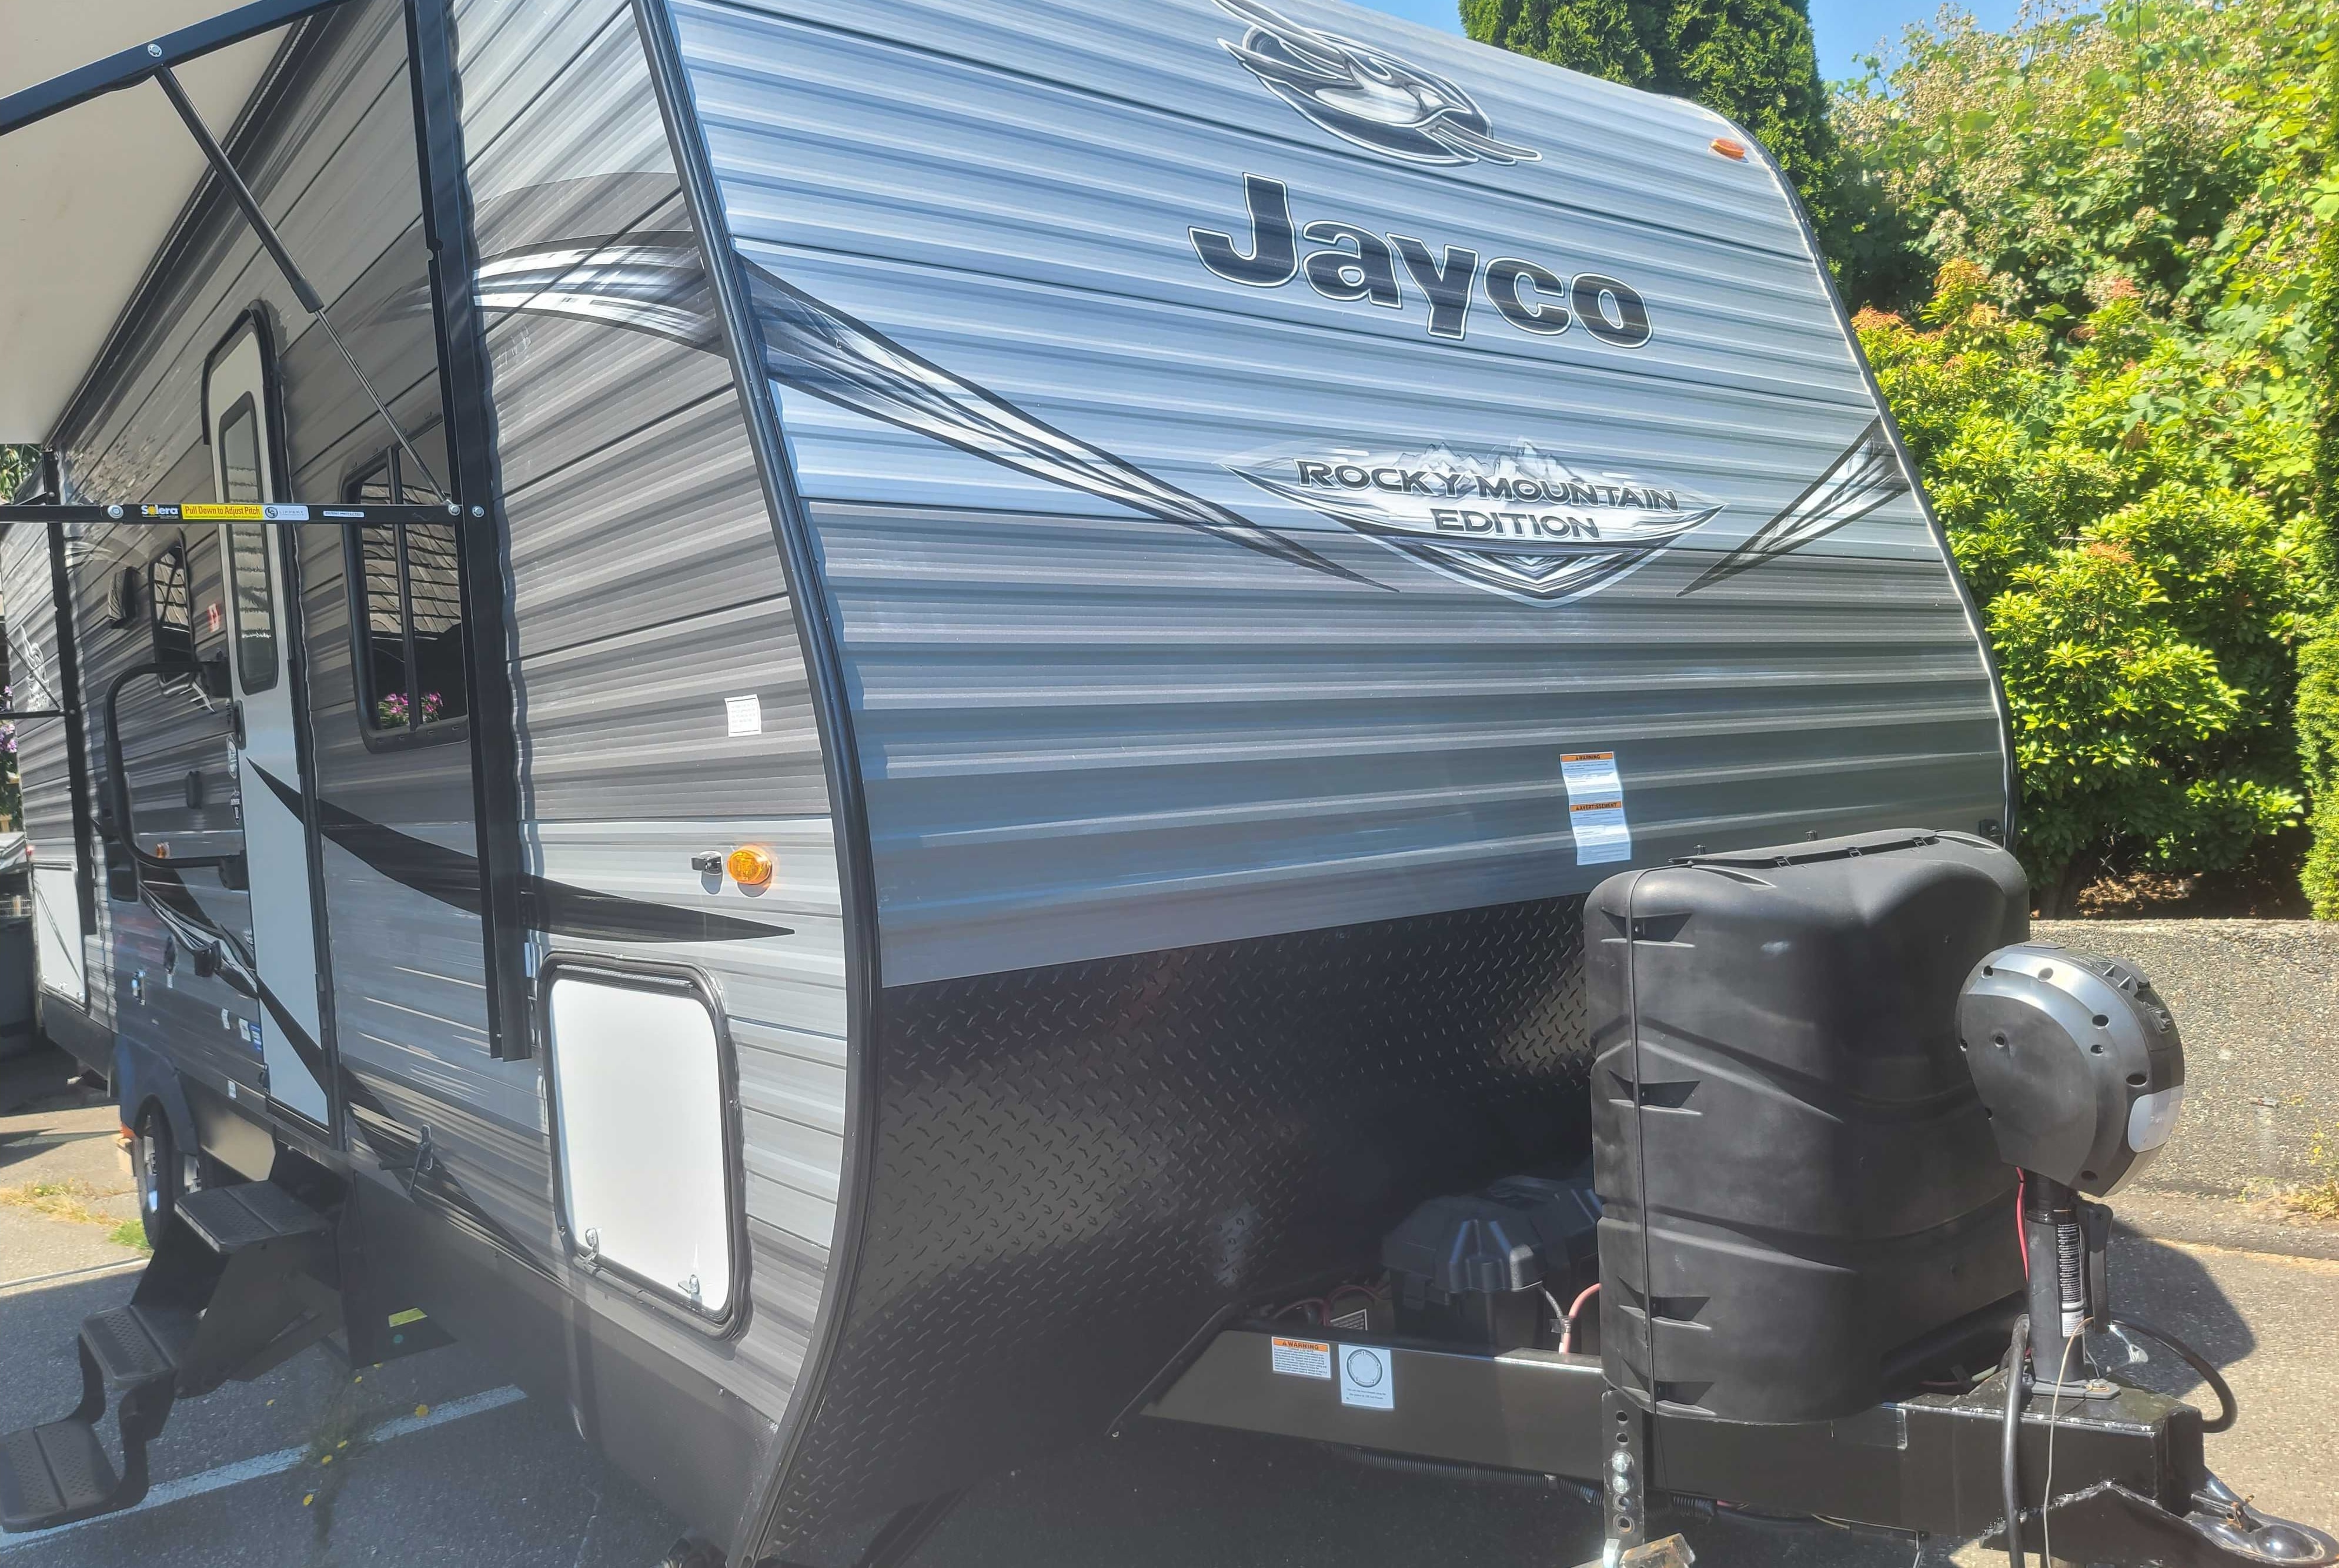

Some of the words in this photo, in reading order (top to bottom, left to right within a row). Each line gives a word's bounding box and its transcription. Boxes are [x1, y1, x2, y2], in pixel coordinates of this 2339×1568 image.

[1187, 170, 1654, 350] Jayco
[1293, 458, 1461, 499] ROCKY
[1472, 473, 1680, 513] MOUNTAIN
[141, 504, 179, 516] Solera
[185, 506, 197, 514] Pull
[198, 506, 216, 514] Down
[225, 506, 243, 516] Adjust
[245, 506, 260, 515] Pitch
[1429, 507, 1602, 540] EDITION
[1288, 1341, 1319, 1350] WARNING
